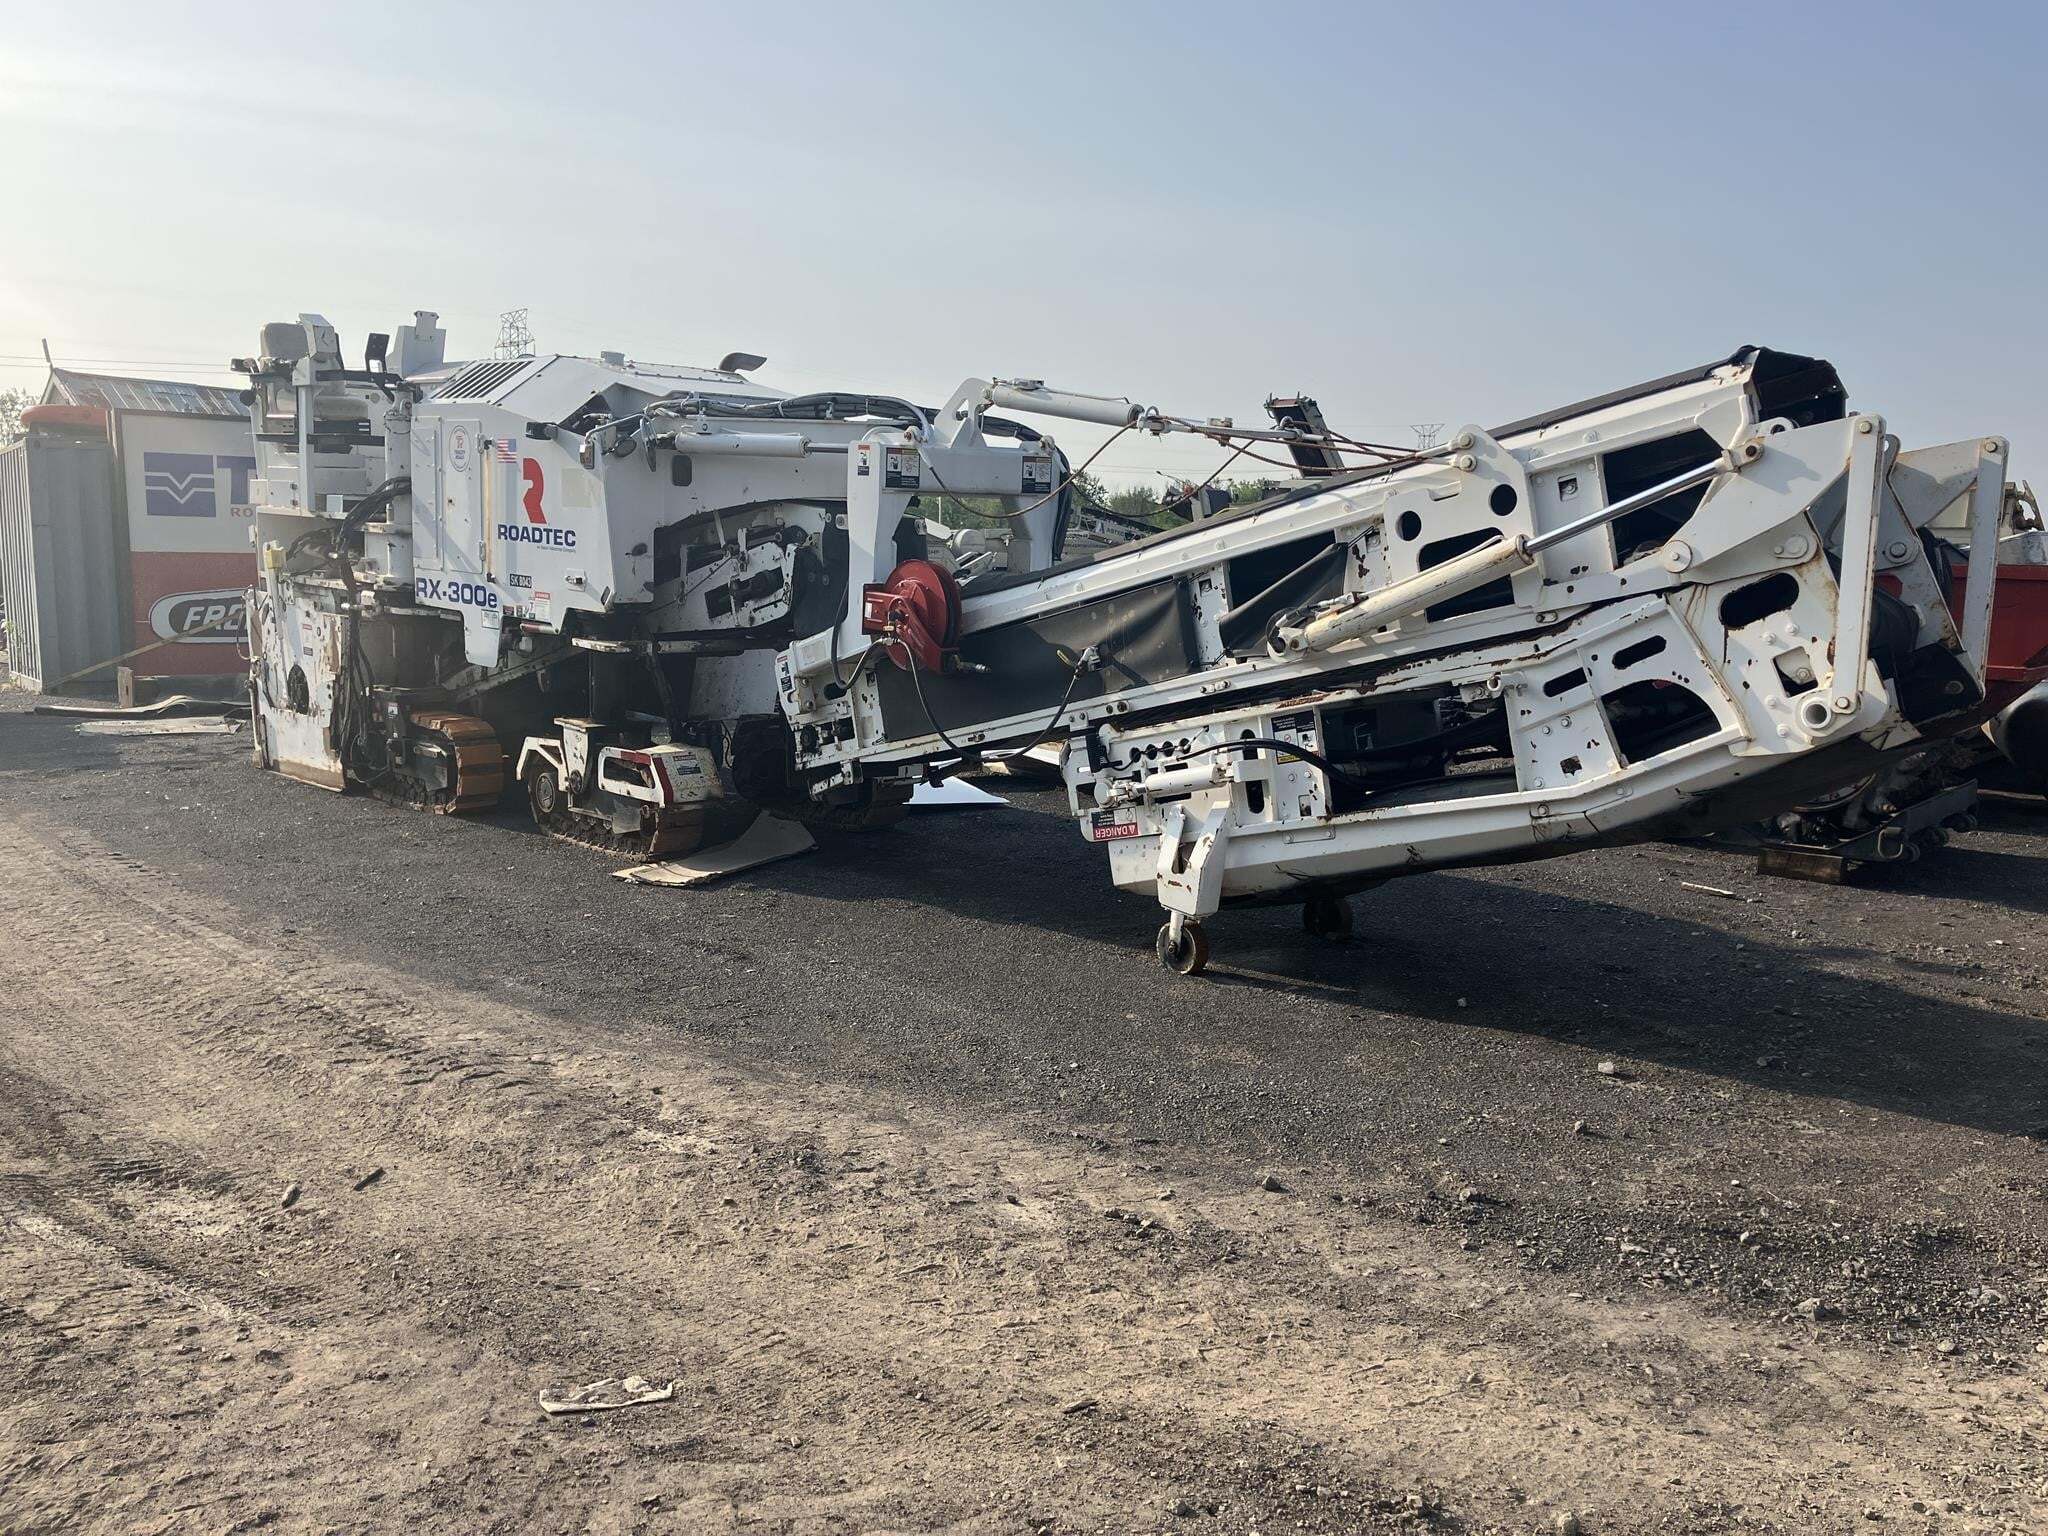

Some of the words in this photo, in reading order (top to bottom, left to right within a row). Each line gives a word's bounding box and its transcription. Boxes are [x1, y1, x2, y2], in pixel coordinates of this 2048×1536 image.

[497, 524, 576, 547] ROADTEC
[415, 577, 498, 609] RX-300e
[183, 604, 248, 632] FRO
[1096, 826, 1128, 838] DANGER
